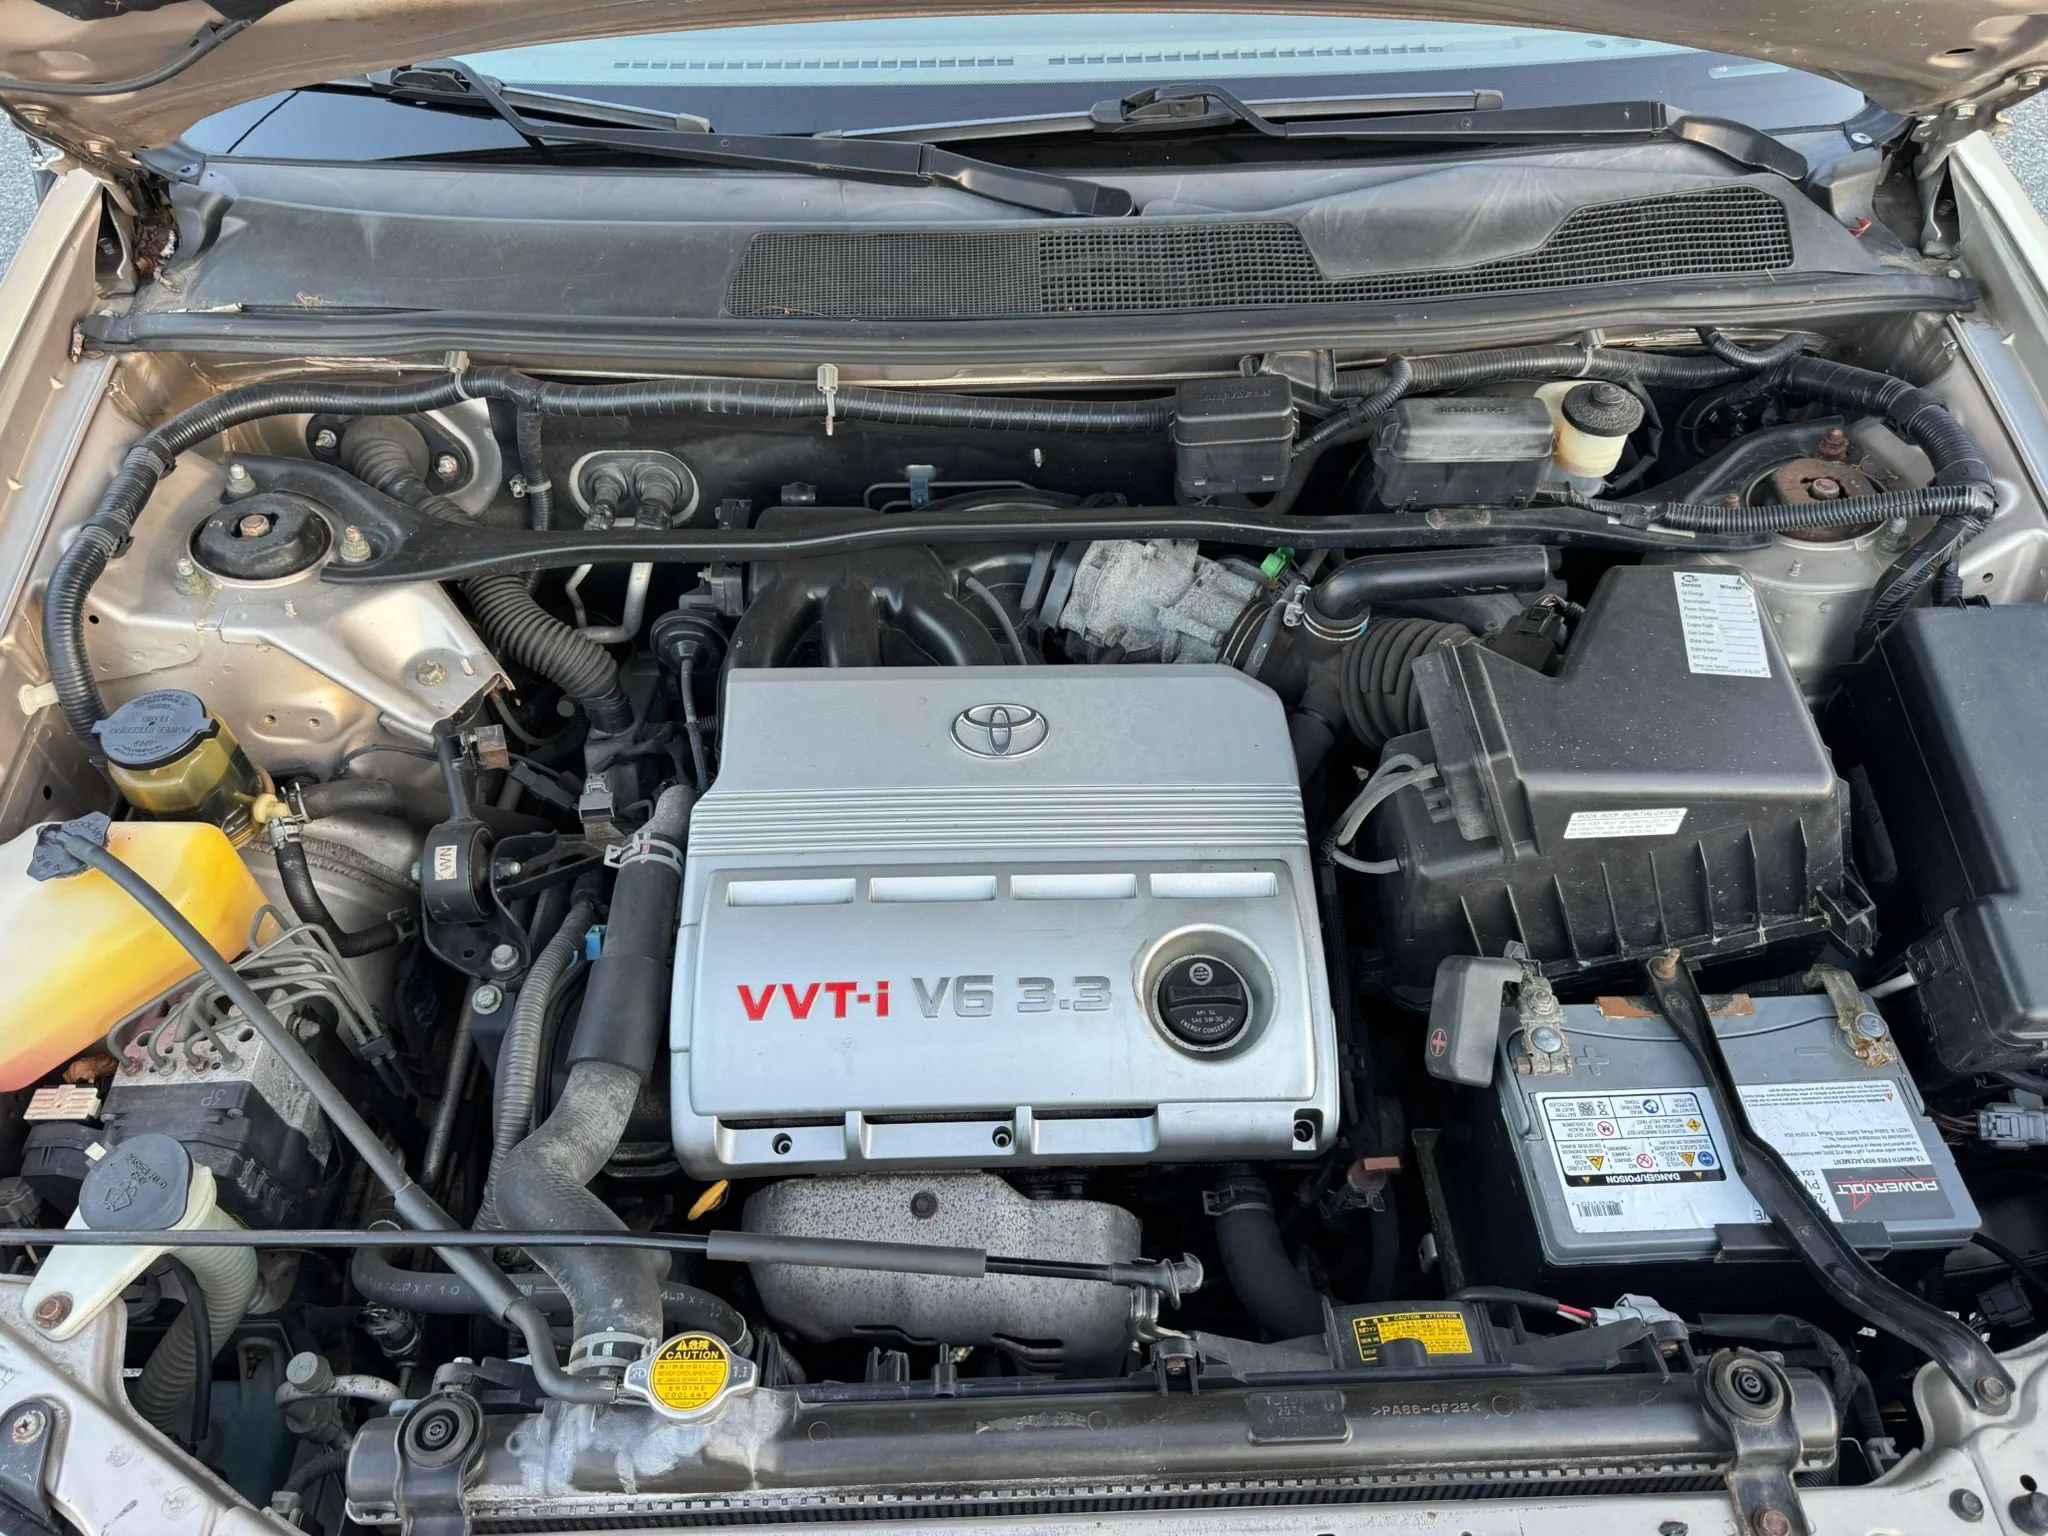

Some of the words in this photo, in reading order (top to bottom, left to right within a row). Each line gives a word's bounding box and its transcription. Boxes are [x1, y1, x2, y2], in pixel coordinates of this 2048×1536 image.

[737, 980, 891, 1020] VVT-i
[912, 975, 994, 1018] V6
[1017, 975, 1112, 1013] 3.3
[1180, 1018, 1202, 1033] ENERGY
[1203, 1016, 1235, 1034] CONSERVING
[1833, 1157, 1876, 1165] REPLACEMENT
[1605, 1172, 1680, 1184] DANGER/POISON
[1836, 1181, 1938, 1196] POWERVOLT
[666, 1350, 719, 1360] CAUTION
